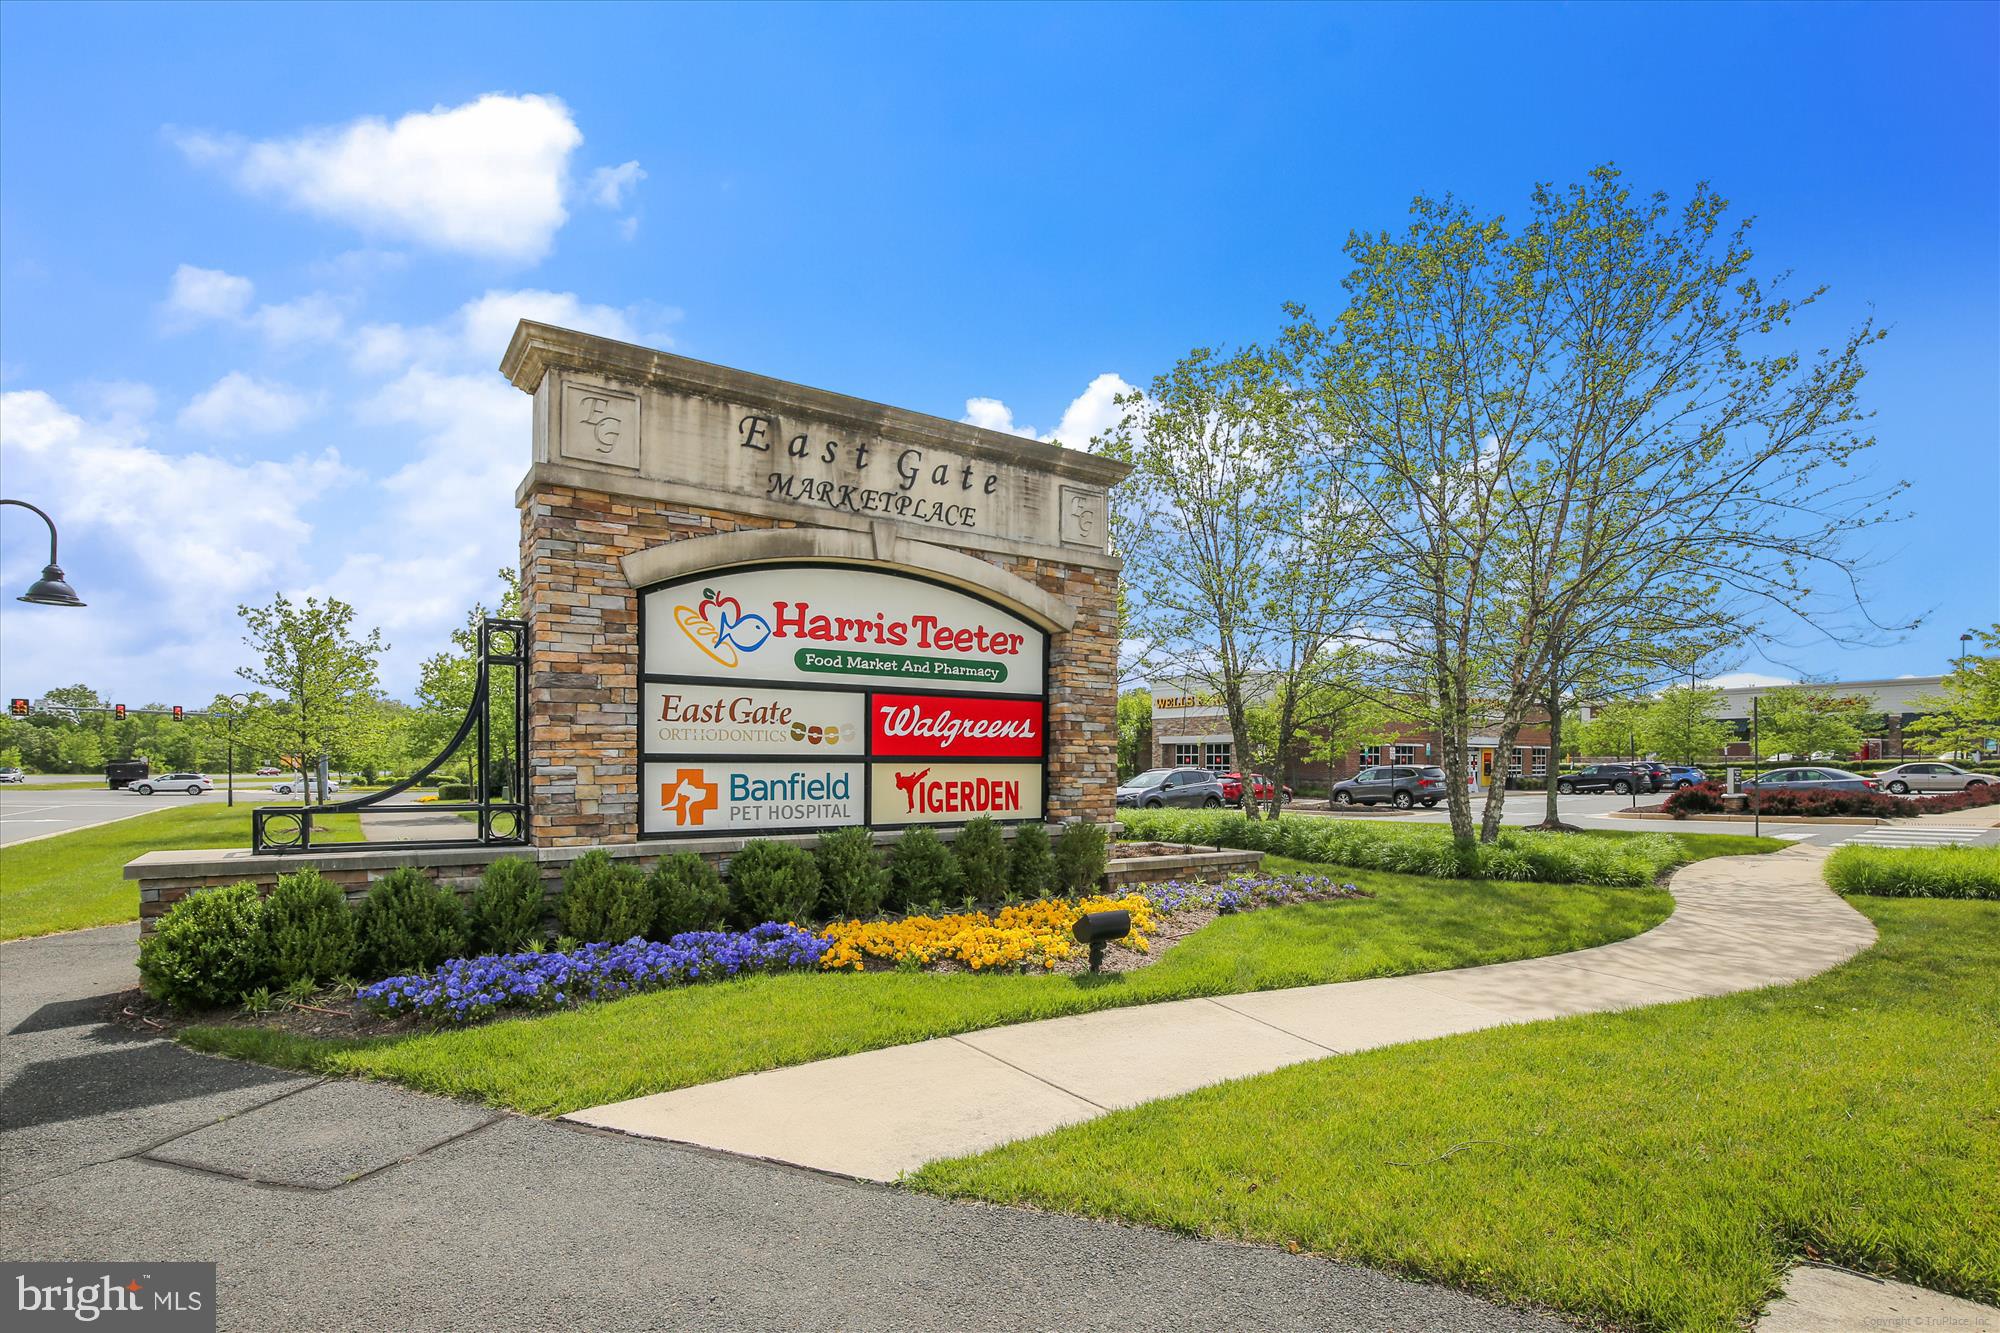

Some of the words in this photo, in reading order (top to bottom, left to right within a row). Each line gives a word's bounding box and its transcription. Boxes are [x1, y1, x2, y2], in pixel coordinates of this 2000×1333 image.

[738, 415, 869, 468] East
[897, 449, 998, 495] Gate
[766, 472, 976, 528] MARKETPLACE
[771, 601, 909, 646] Harris
[911, 614, 1024, 655] Teeter
[805, 653, 843, 668] Food
[847, 656, 898, 671] Market
[901, 659, 930, 674] And
[934, 662, 1000, 680] Pharmacy
[657, 694, 726, 724] East
[729, 697, 792, 725] Gate
[1156, 696, 1195, 709] WELLS
[658, 727, 787, 743] ORTHODONTICS
[880, 704, 1036, 748] Walgreens
[730, 772, 850, 802] Banfield
[730, 805, 762, 821] PET
[768, 803, 851, 820] HOSPITAL
